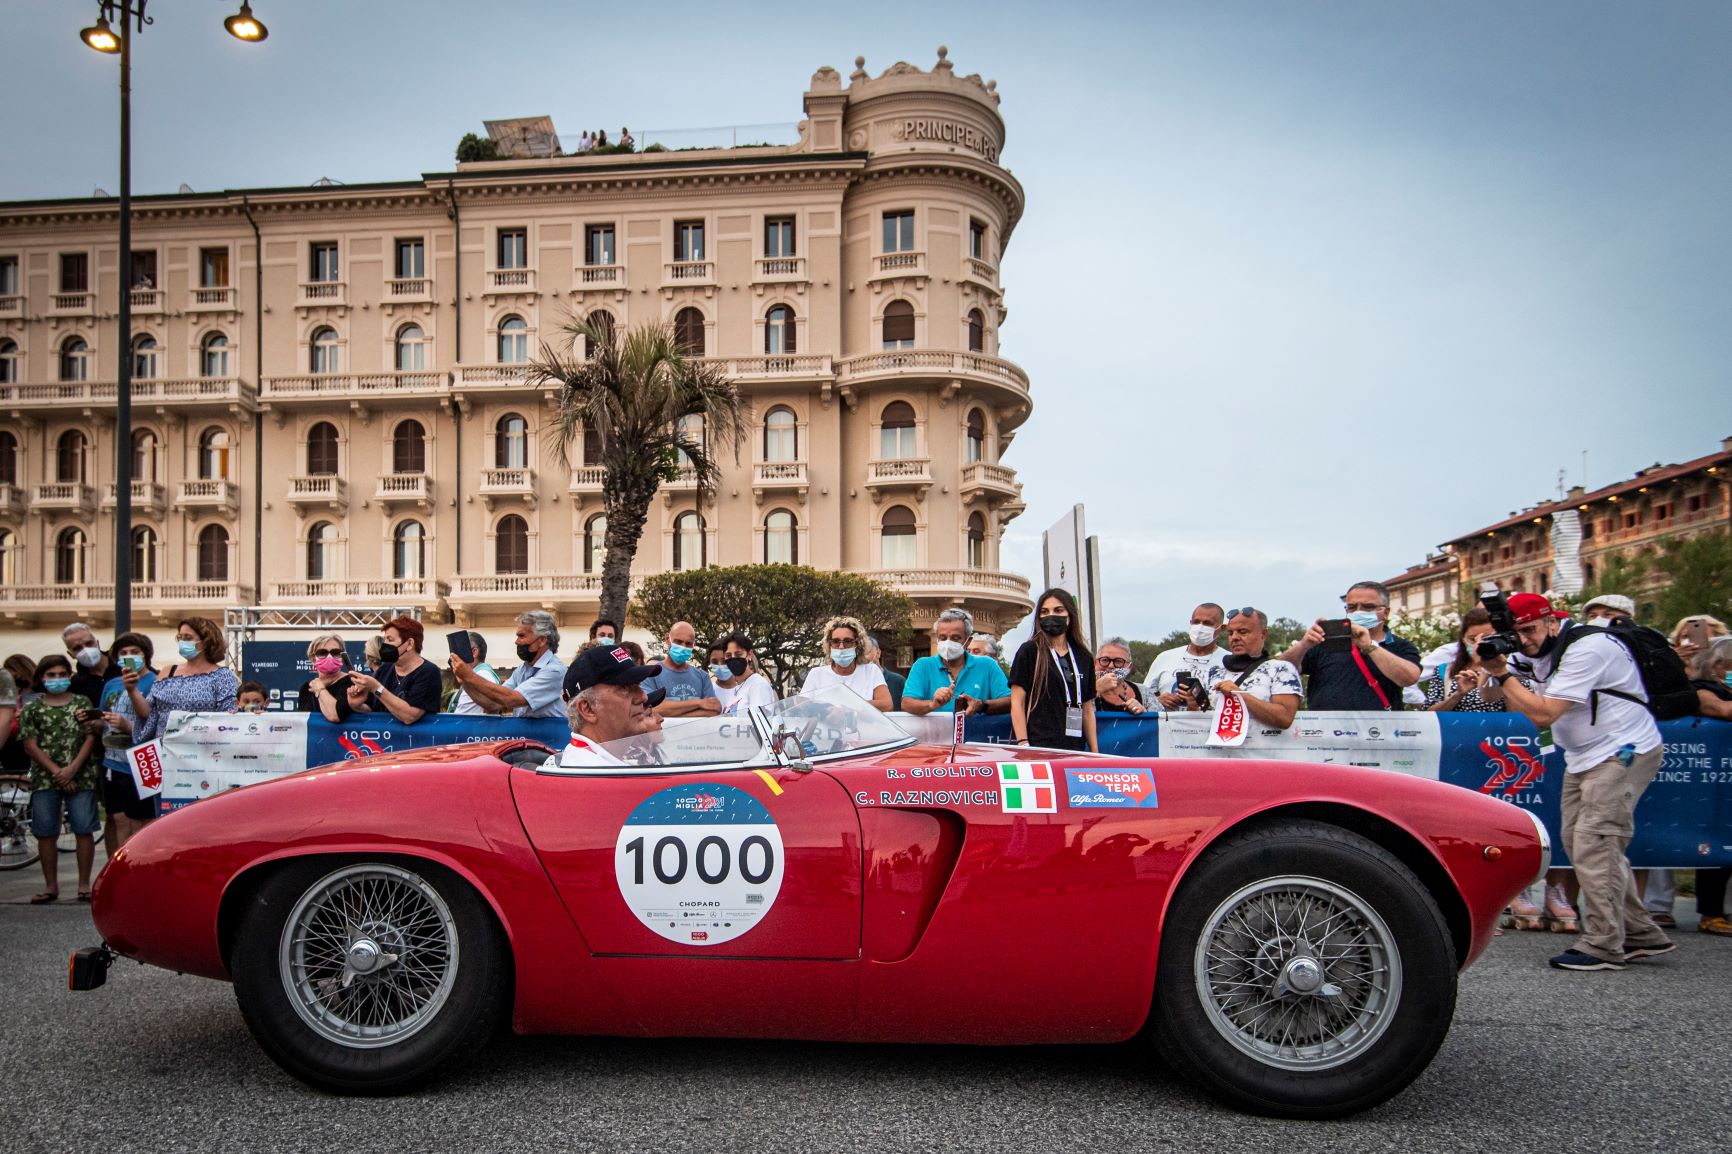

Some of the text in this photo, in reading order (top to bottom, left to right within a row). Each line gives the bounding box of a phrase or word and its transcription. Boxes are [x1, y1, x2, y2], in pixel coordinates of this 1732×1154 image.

[904, 119, 973, 148] PRINCIPE
[353, 664, 363, 672] 16
[1220, 698, 1233, 730] 1000
[343, 730, 391, 740] 1000
[719, 724, 843, 740] CHARD
[1663, 743, 1707, 753] SSING
[137, 752, 151, 780] 1000
[146, 745, 162, 778] MIGLIA
[1686, 757, 1712, 768] THE
[886, 766, 994, 779] R. GIOLITO
[1078, 774, 1140, 783] SPONSOR
[1105, 783, 1142, 793] TEAM
[855, 790, 998, 805] C. RAZNOVICH
[1070, 793, 1126, 806] Alfa Romeo
[1488, 793, 1543, 803] GLIA
[625, 835, 774, 885] 1000
